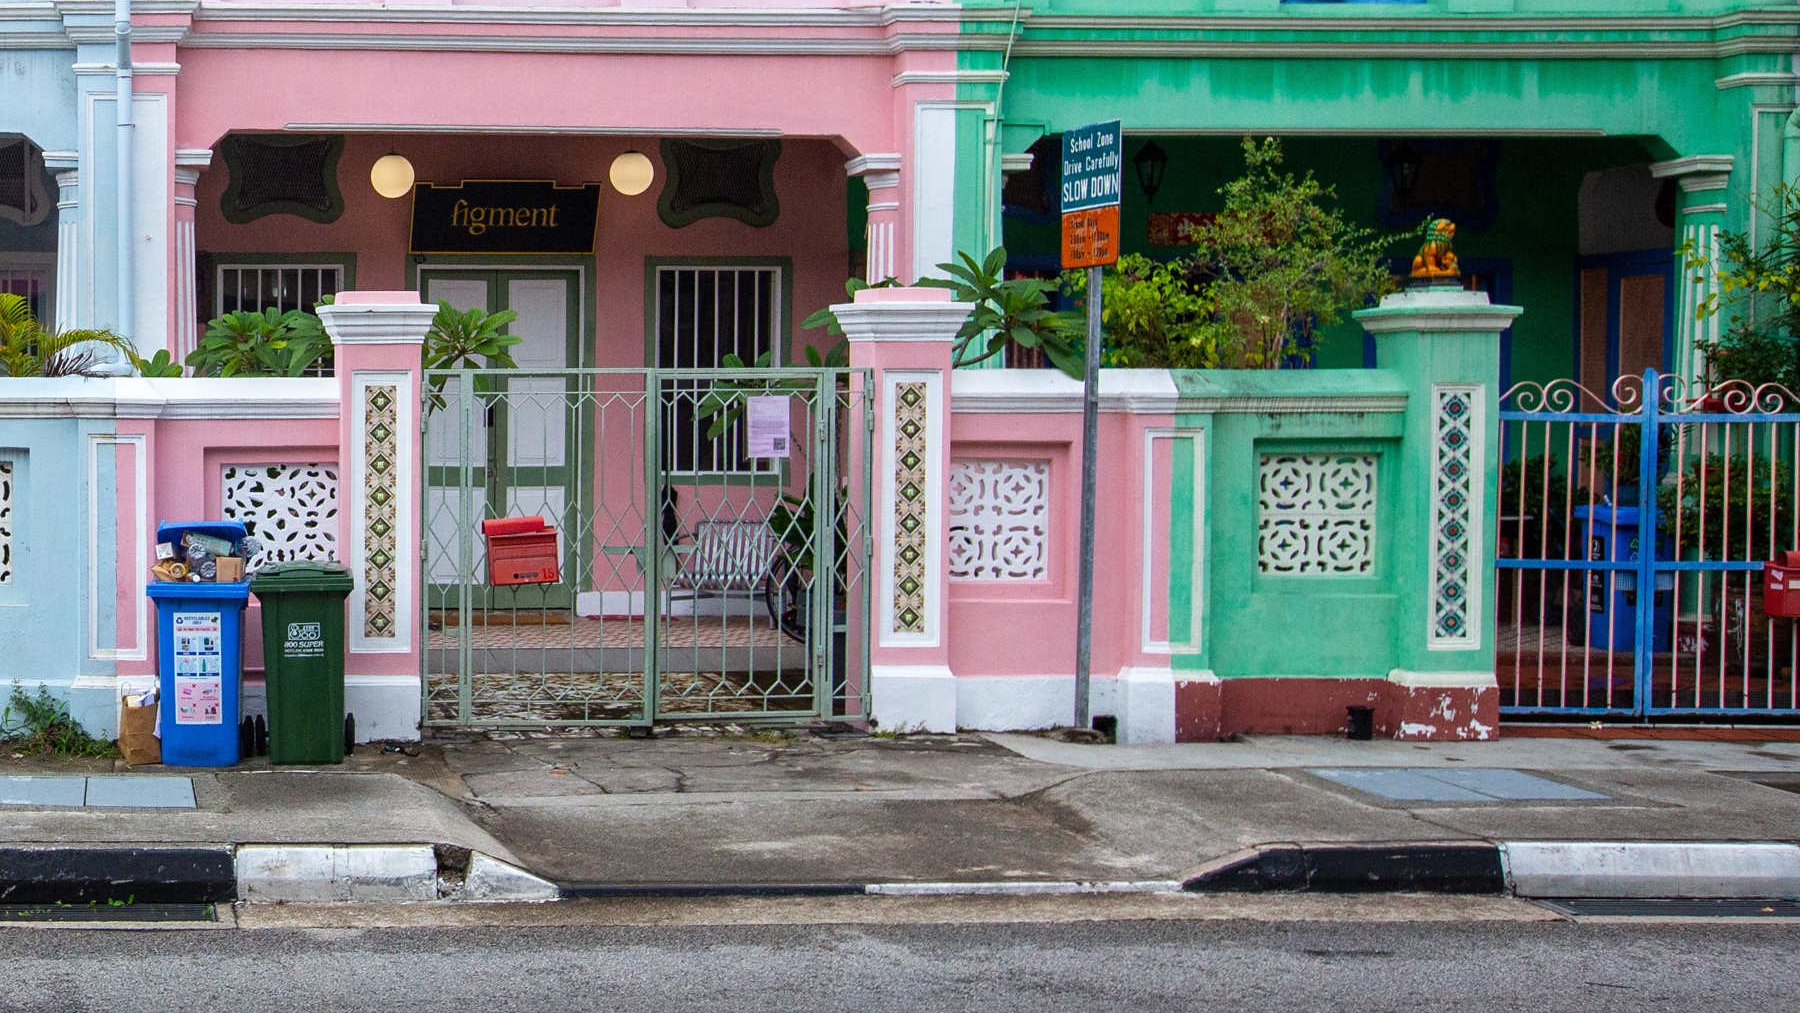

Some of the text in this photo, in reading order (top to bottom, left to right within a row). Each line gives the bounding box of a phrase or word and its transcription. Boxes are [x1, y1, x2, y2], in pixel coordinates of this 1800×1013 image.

[1070, 131, 1114, 153] School Zone
[1064, 152, 1119, 176] Drive Carefully
[1063, 172, 1119, 202] SLOW DOWN
[451, 199, 560, 235] figment
[542, 568, 555, 579] 15
[299, 640, 324, 648] SUPER
